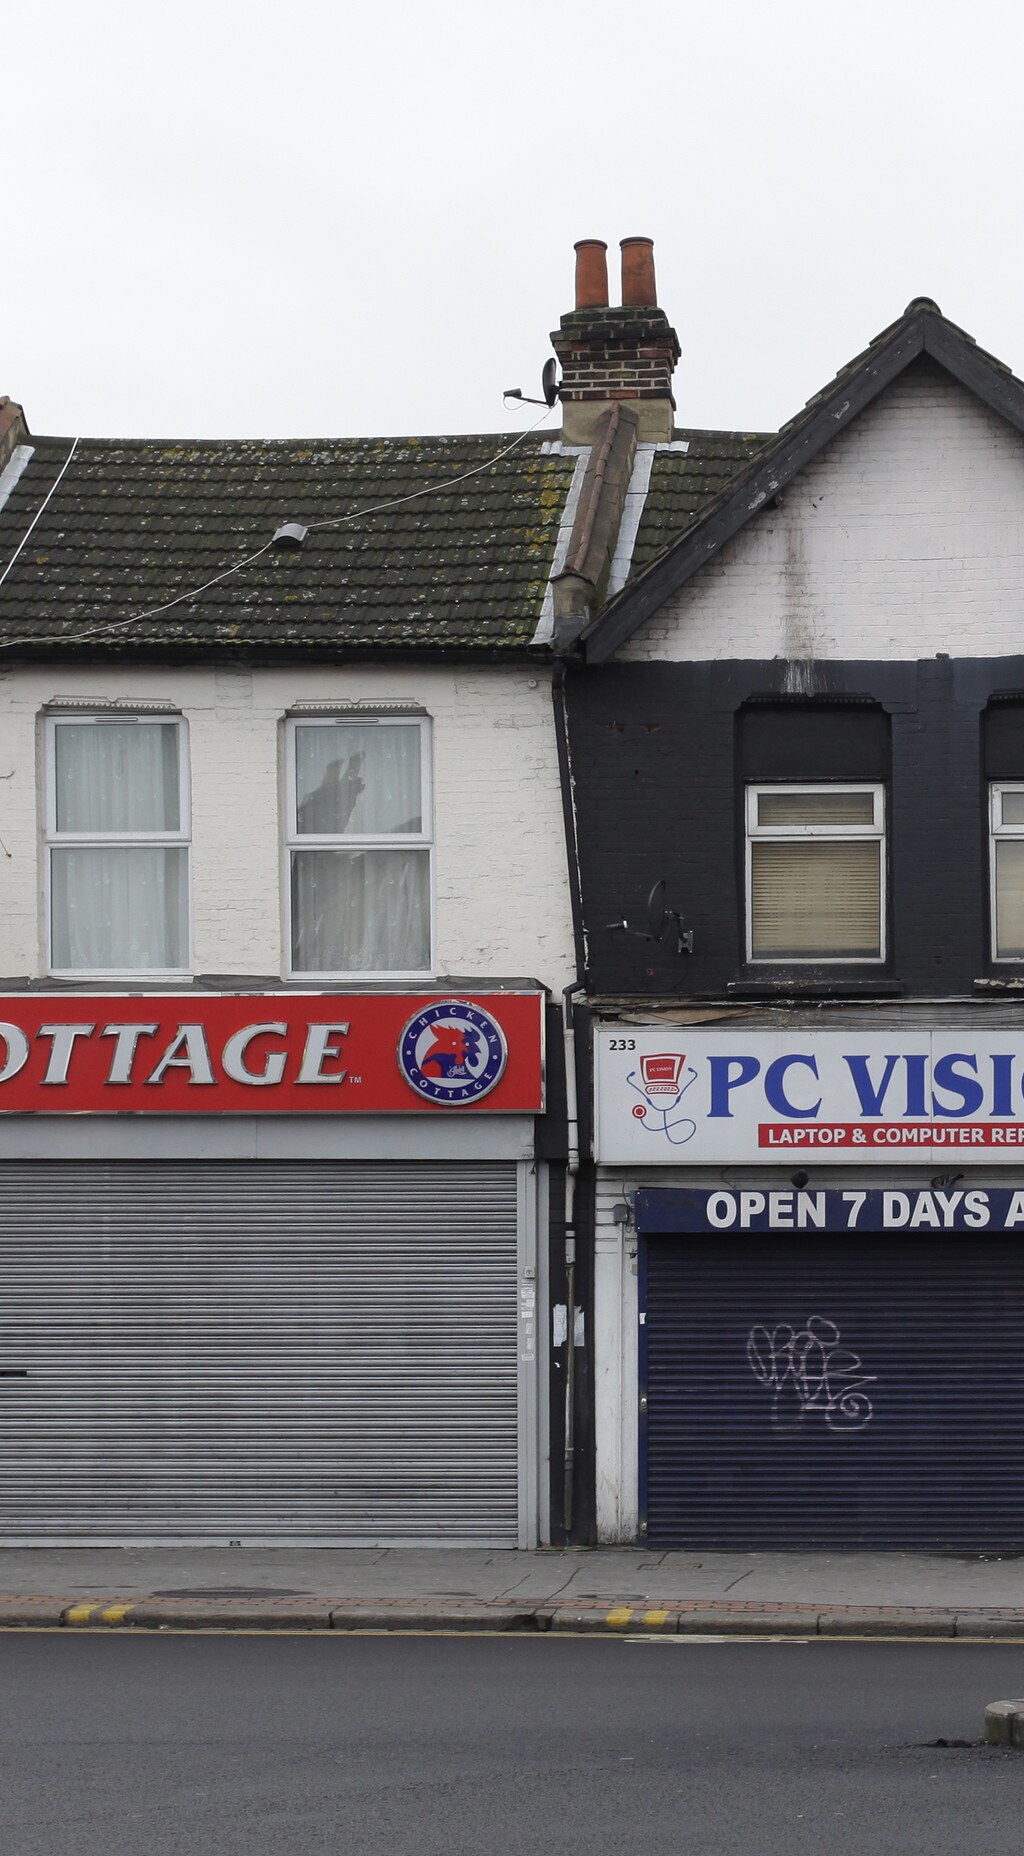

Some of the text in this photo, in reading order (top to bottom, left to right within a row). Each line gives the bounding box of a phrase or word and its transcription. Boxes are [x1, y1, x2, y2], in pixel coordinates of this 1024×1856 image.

[408, 1007, 498, 1044] CHICKEN
[608, 1039, 636, 1051] 233
[409, 1068, 493, 1098] COTTAGE
[706, 1053, 823, 1118] PC
[768, 1128, 849, 1144] LAPTOP
[851, 1128, 867, 1144] &
[872, 1127, 985, 1144] COMPUTER
[706, 1190, 826, 1228] OPEN
[842, 1191, 867, 1227] 7
[883, 1190, 991, 1228] DAYS
